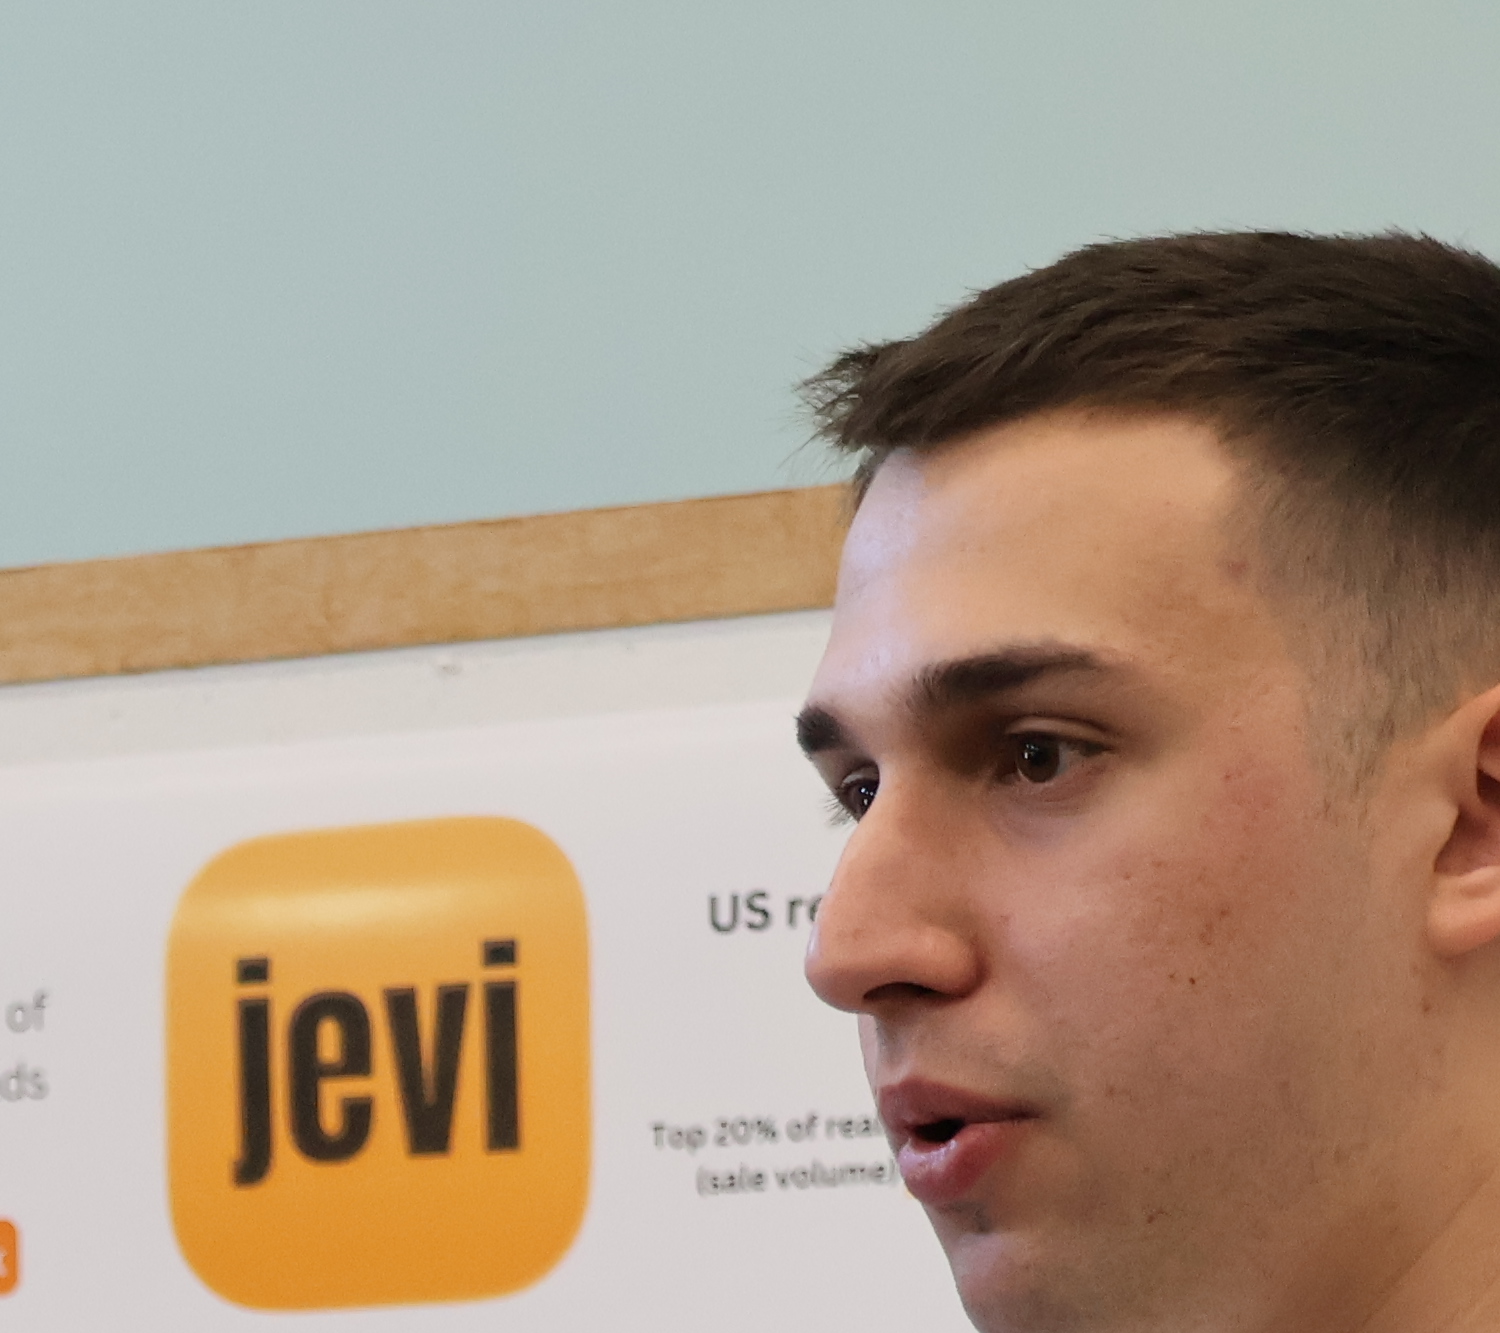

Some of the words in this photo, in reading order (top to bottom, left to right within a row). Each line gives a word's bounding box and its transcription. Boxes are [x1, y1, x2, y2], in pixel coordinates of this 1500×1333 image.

[708, 890, 772, 935] US
[5, 991, 48, 1034] of
[233, 938, 520, 1188] jevi
[652, 1119, 706, 1155] Top
[716, 1118, 780, 1148] 20%
[788, 1112, 819, 1143] of
[696, 1162, 766, 1199] (sale
[773, 1155, 898, 1194] volume)
